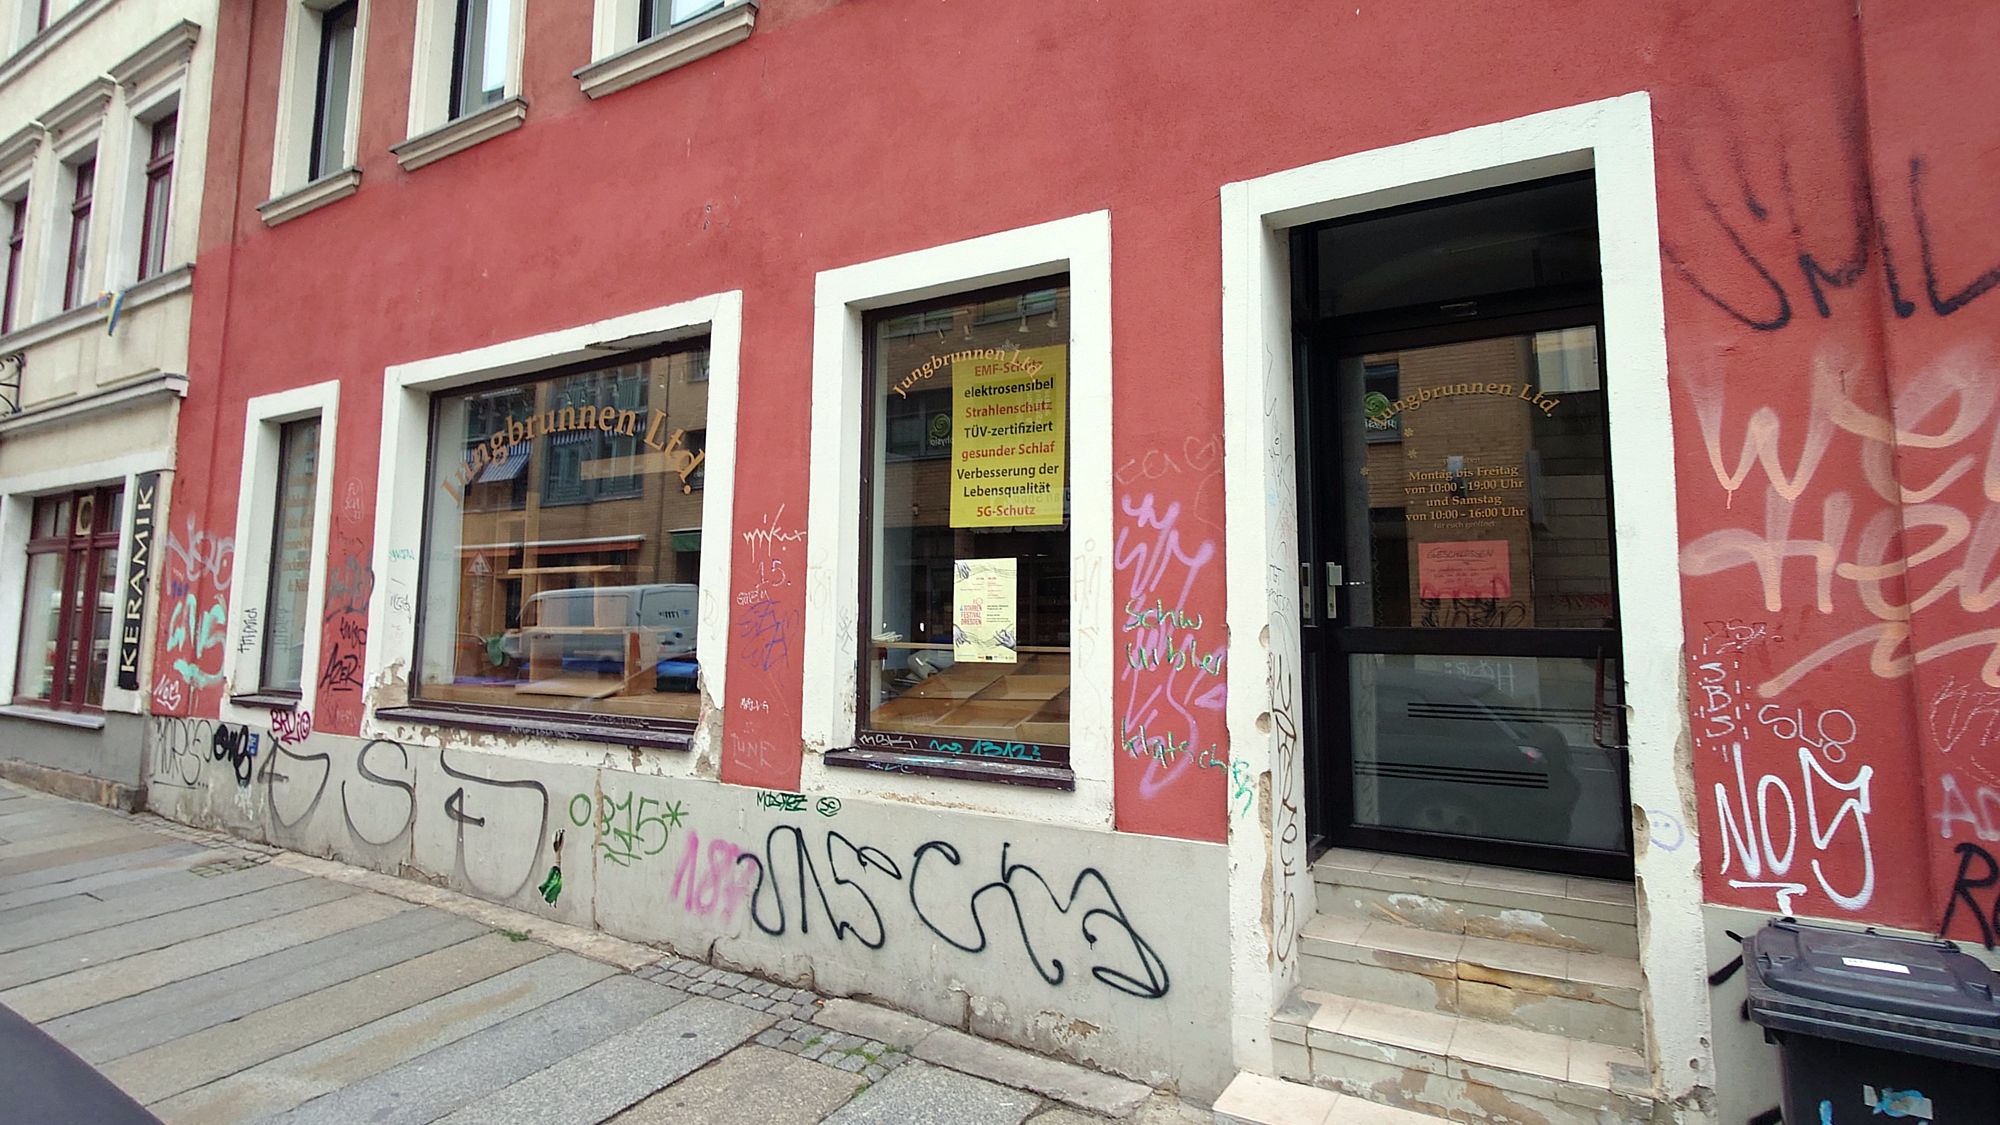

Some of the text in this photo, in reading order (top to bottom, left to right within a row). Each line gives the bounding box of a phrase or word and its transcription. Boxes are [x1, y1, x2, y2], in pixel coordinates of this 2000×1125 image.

[892, 348, 1006, 399] Jungbrunnen
[964, 377, 1054, 399] elektrosensibel
[965, 400, 1053, 419] Strahlenschutz
[1371, 381, 1514, 428] Jungbrunnen
[1518, 383, 1561, 418] Ltd.
[964, 420, 1054, 439] TÜV-zertifiziert
[440, 403, 637, 505] Jungbrunnen
[642, 408, 706, 496] Ltd.
[961, 440, 1056, 463] gesunder Schlaf
[956, 463, 1060, 481] Verbesserung der
[1408, 465, 1520, 482] Montag bis Freitag
[963, 481, 1051, 498] Lebensqualität
[1404, 484, 1426, 495] von
[1429, 482, 1457, 494] 10:00
[1467, 480, 1497, 492] 19:00
[1500, 478, 1525, 490] Uhr
[1426, 494, 1503, 508] und Samstag
[976, 504, 1036, 518] 5G-Schutz
[1405, 511, 1427, 522] von
[1430, 509, 1459, 521] 10:00
[1469, 507, 1498, 519] 16:00
[1501, 506, 1526, 518] Uhr
[120, 485, 154, 673] KERAMIK
